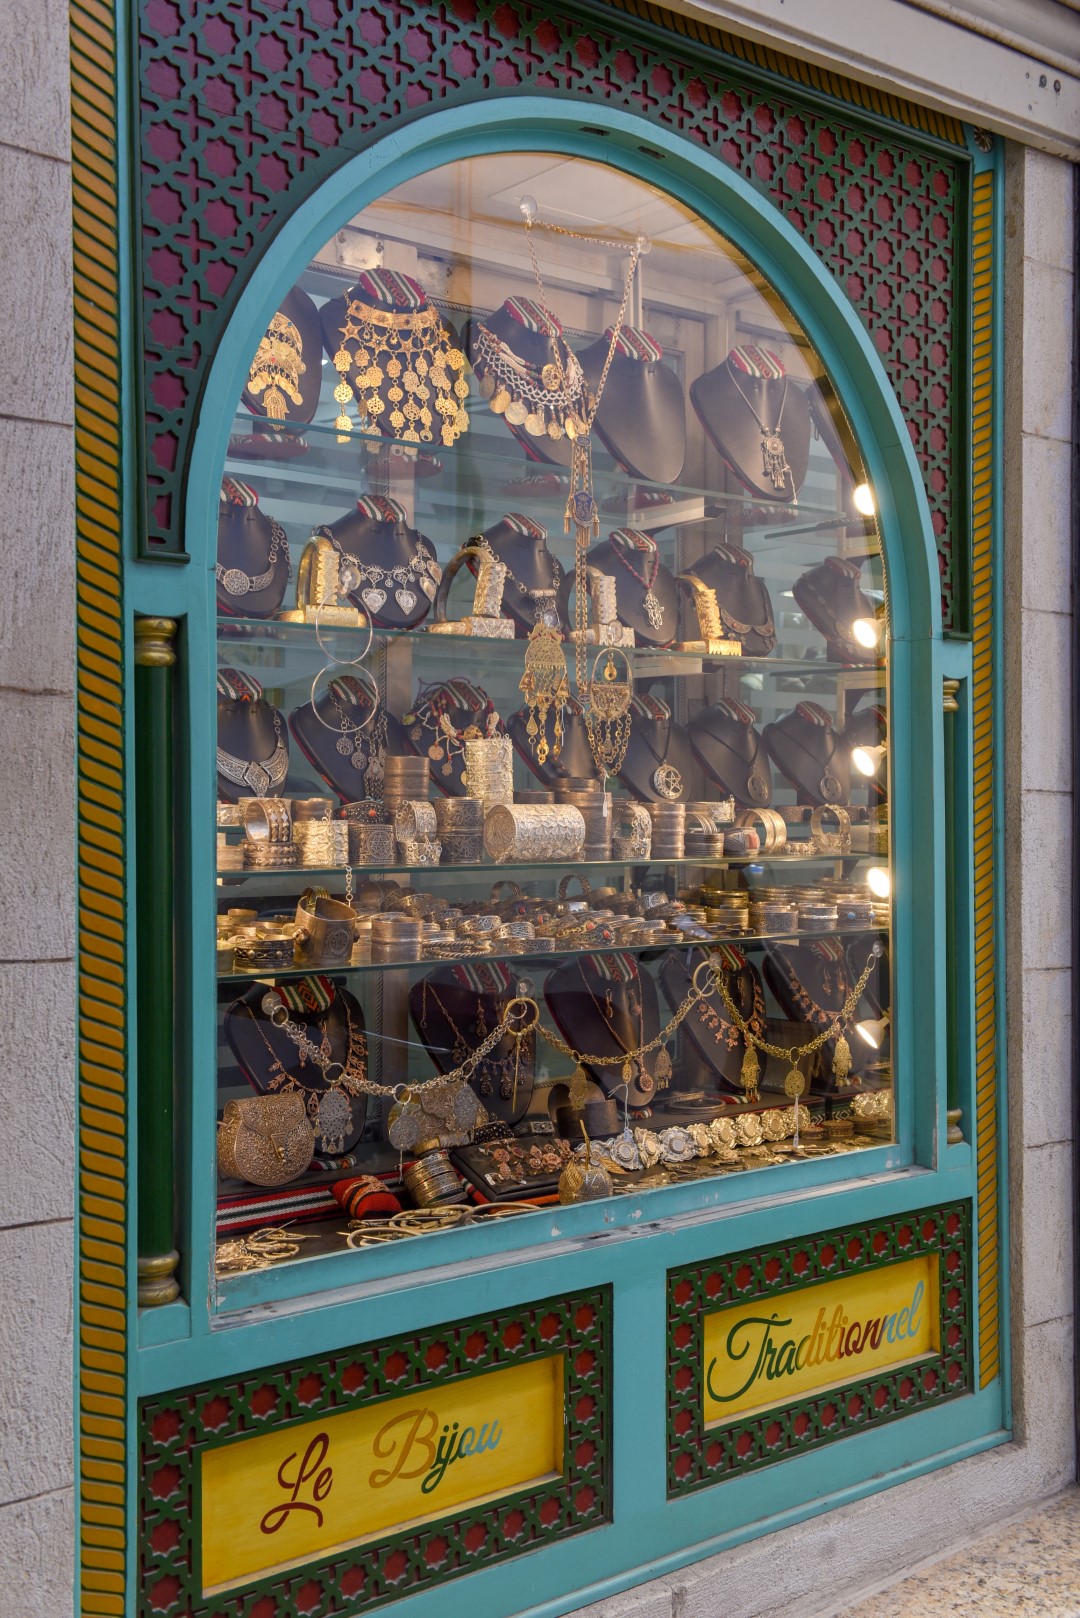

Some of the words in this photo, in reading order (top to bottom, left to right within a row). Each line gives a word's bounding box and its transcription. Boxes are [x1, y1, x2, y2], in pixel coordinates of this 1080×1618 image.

[706, 1280, 925, 1403] Traditionnel
[260, 1432, 333, 1534] Le
[368, 1407, 503, 1494] Bijou
